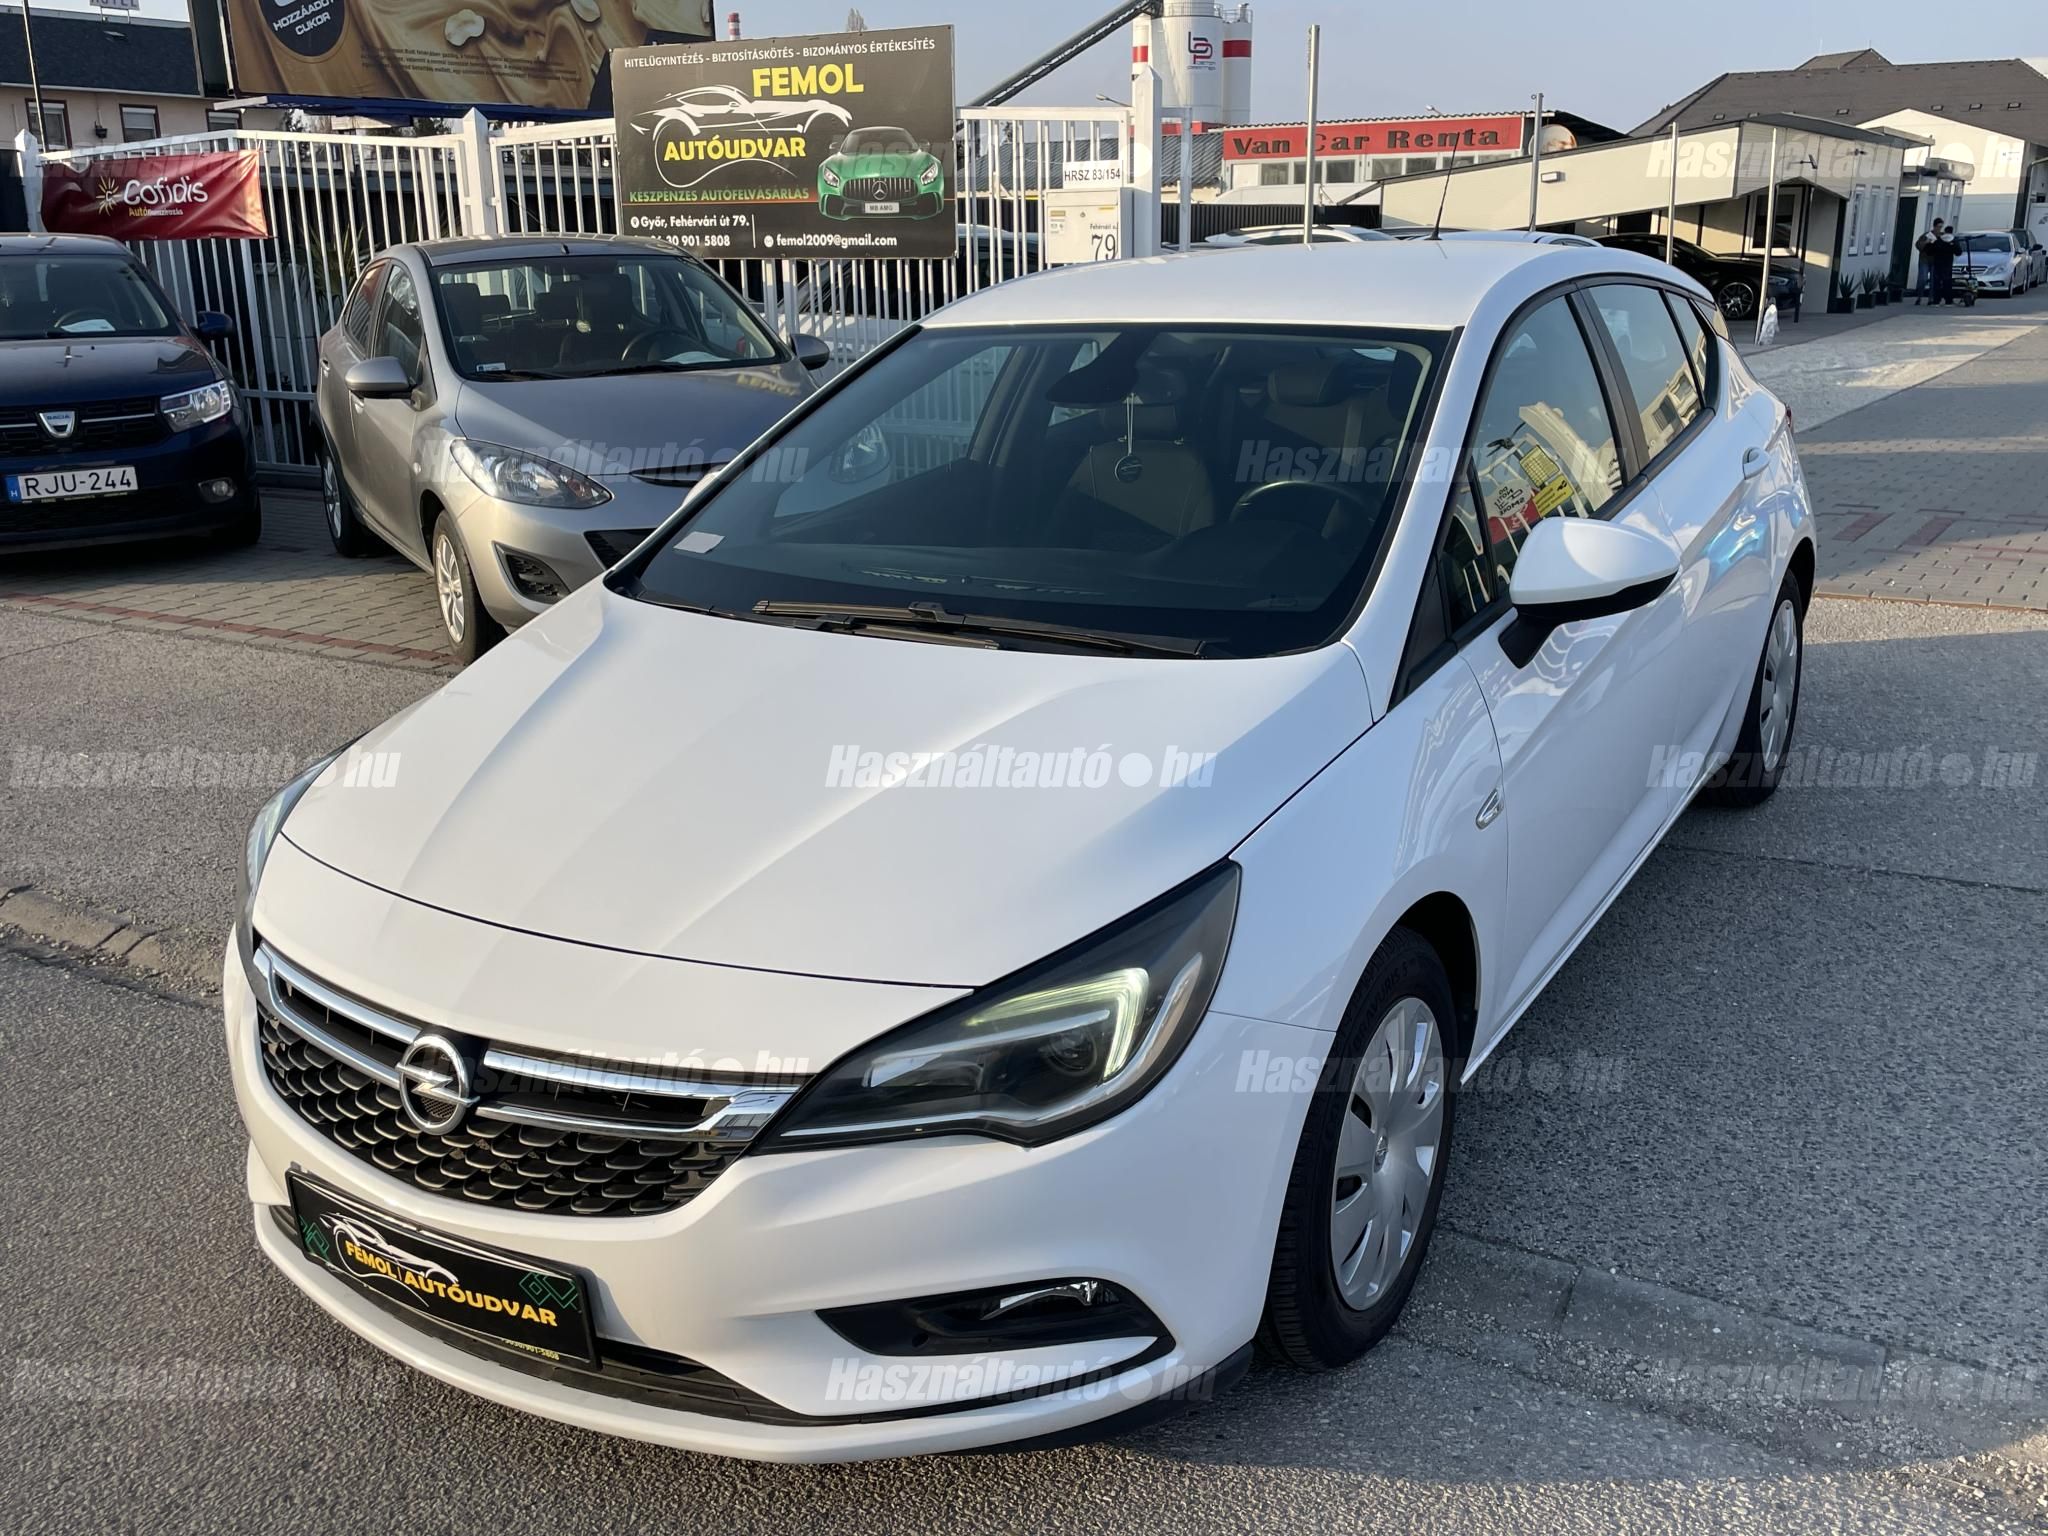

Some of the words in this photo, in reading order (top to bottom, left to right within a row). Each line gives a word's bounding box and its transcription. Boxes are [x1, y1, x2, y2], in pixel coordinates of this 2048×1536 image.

[295, 12, 331, 35] CUKOR
[624, 53, 704, 68] HITELÜGYINTÉZÉS
[712, 46, 794, 63] BIZTOSÍTÁSKÖTÉS
[803, 43, 868, 57] BIZOMÁNYOS
[870, 38, 936, 53] ÉRTÉKESÍTÉS
[752, 63, 865, 97] FEMOL
[663, 134, 807, 161] AUTÓUDVAR
[1233, 137, 1290, 155] Van
[1064, 169, 1090, 181] HRSZ
[1092, 168, 1121, 180] 83/154
[123, 176, 209, 205] Cofidis
[629, 188, 698, 202] KÉSZPÉNZES
[701, 185, 809, 201] AUTÓFELVÁSÁRLÁS
[640, 215, 668, 230] Győr,
[670, 213, 717, 227] Fehérvári
[719, 213, 730, 227] út
[732, 215, 750, 227] 79.
[681, 235, 700, 247] 901
[704, 234, 731, 247] 5808
[776, 233, 898, 249] femol2009@gmail.com
[1091, 233, 1116, 260] 79
[25, 470, 131, 496] RJU-244
[345, 1240, 397, 1279] FEMOL
[404, 1270, 558, 1327] AUTÓUDVAR
